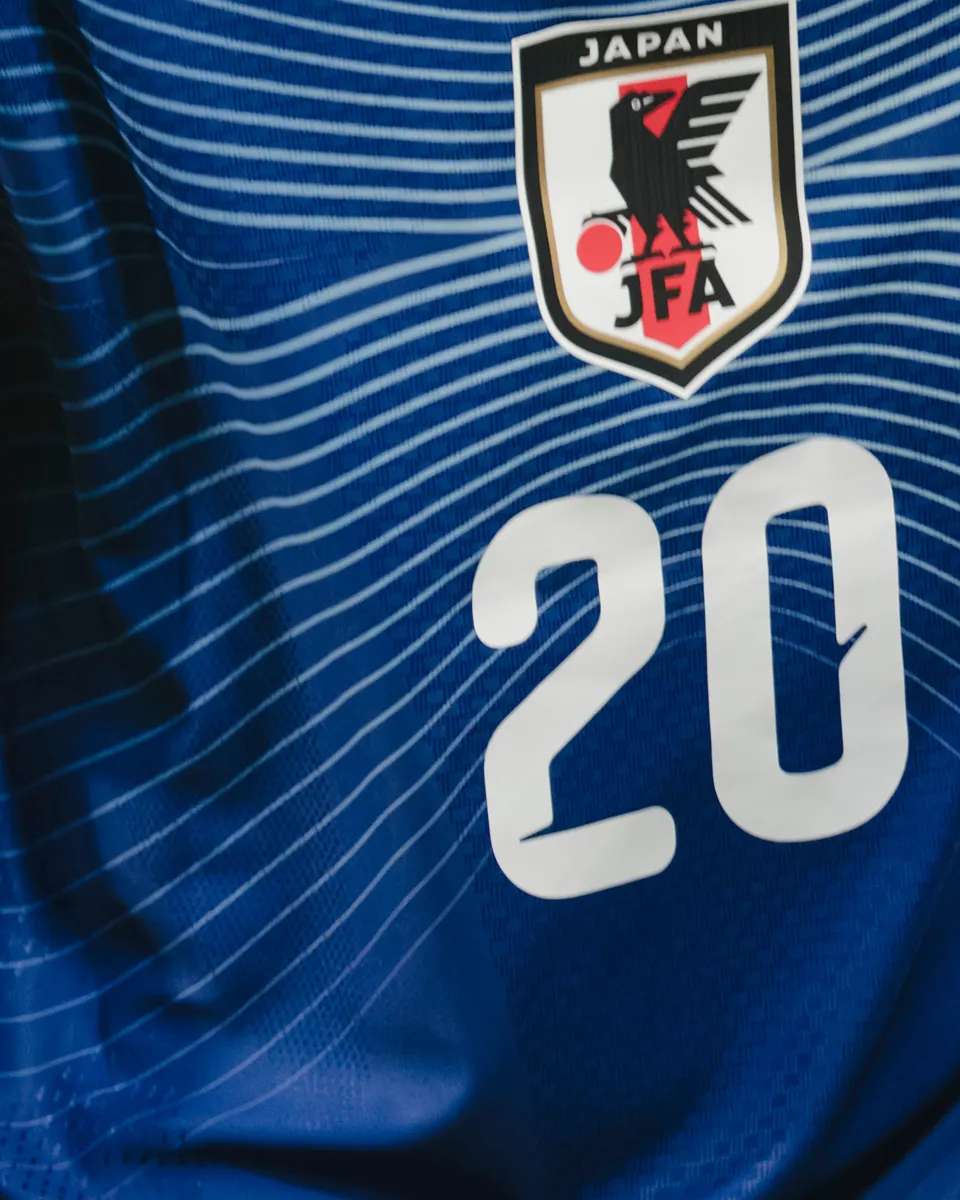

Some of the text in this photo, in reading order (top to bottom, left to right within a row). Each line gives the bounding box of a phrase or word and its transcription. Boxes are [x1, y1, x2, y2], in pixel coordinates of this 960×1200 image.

[579, 20, 722, 67] JAPAN
[614, 260, 735, 328] JFA
[472, 436, 909, 900] 20
